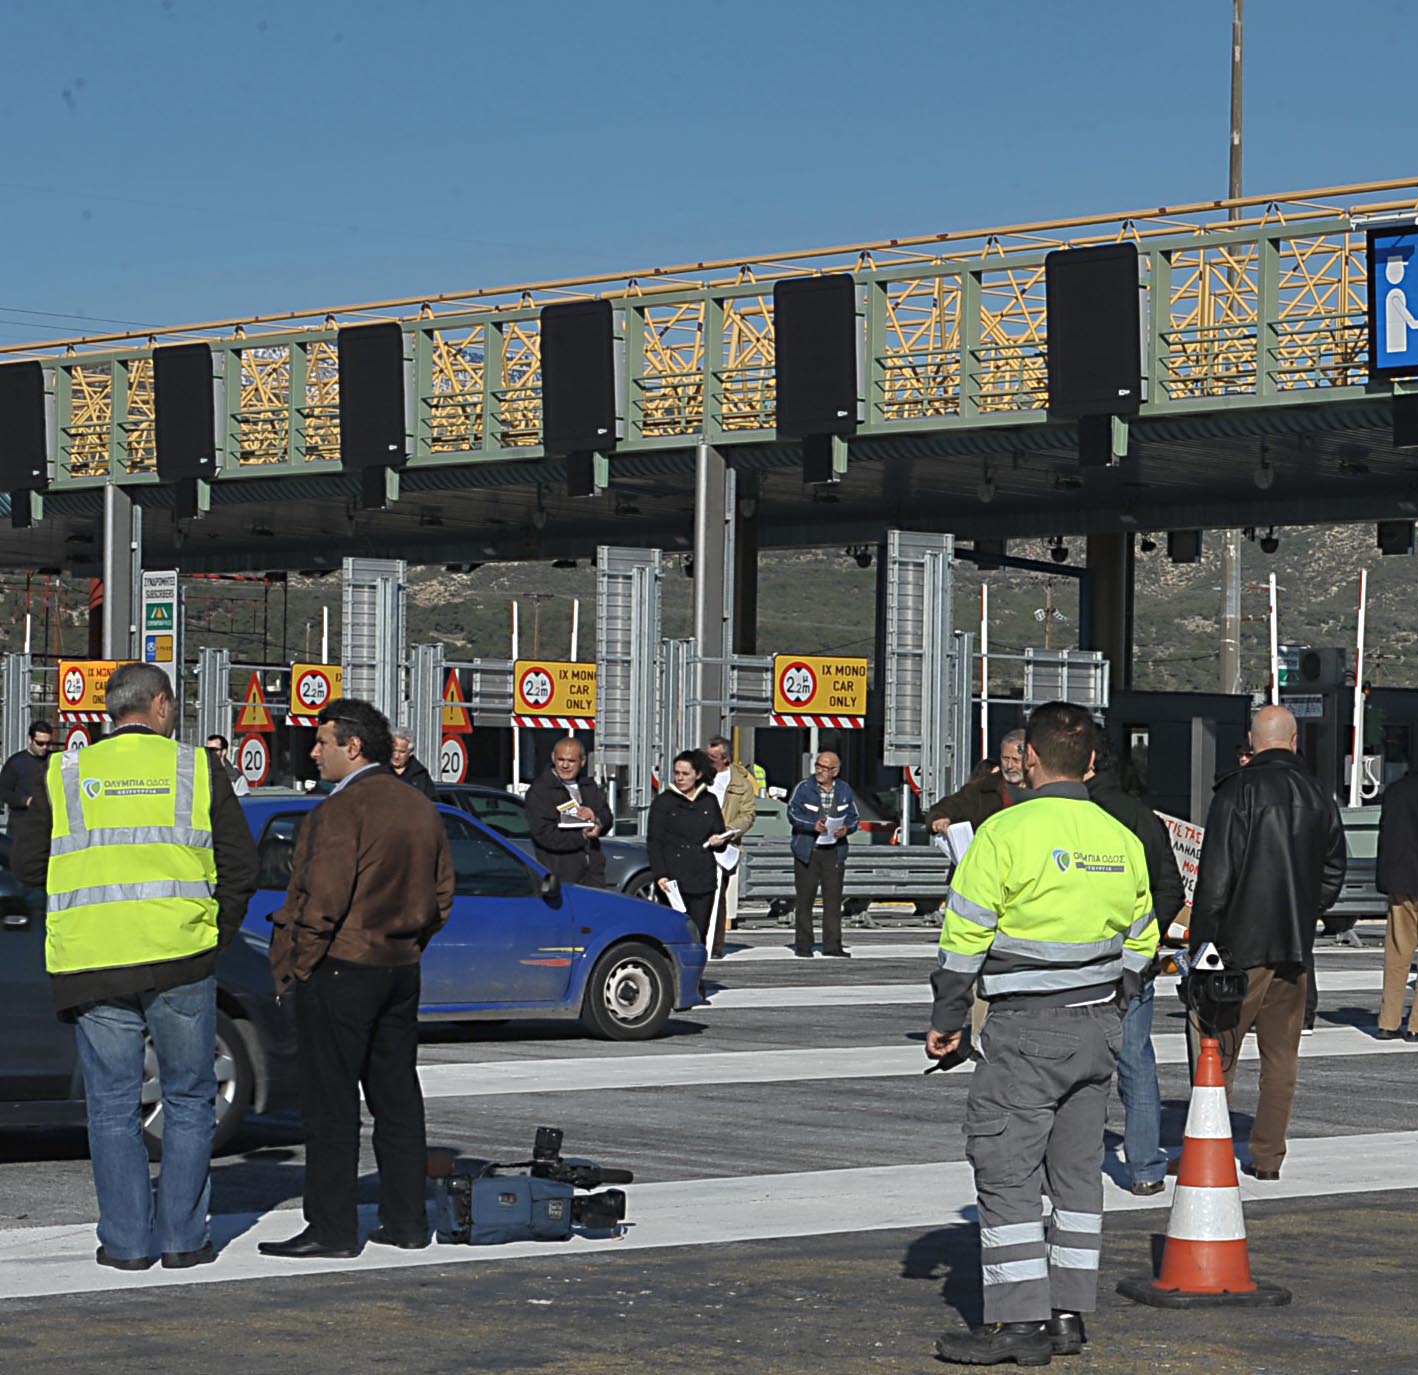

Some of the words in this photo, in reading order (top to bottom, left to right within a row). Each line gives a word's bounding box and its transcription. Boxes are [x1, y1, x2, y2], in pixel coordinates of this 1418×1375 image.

[571, 670, 597, 681] ΜΟΝ
[569, 685, 590, 695] CAR
[832, 681, 854, 692] CAR
[566, 699, 593, 710] ONLY
[829, 696, 858, 708] ONLY
[244, 750, 263, 771] 20
[441, 752, 461, 773] 20
